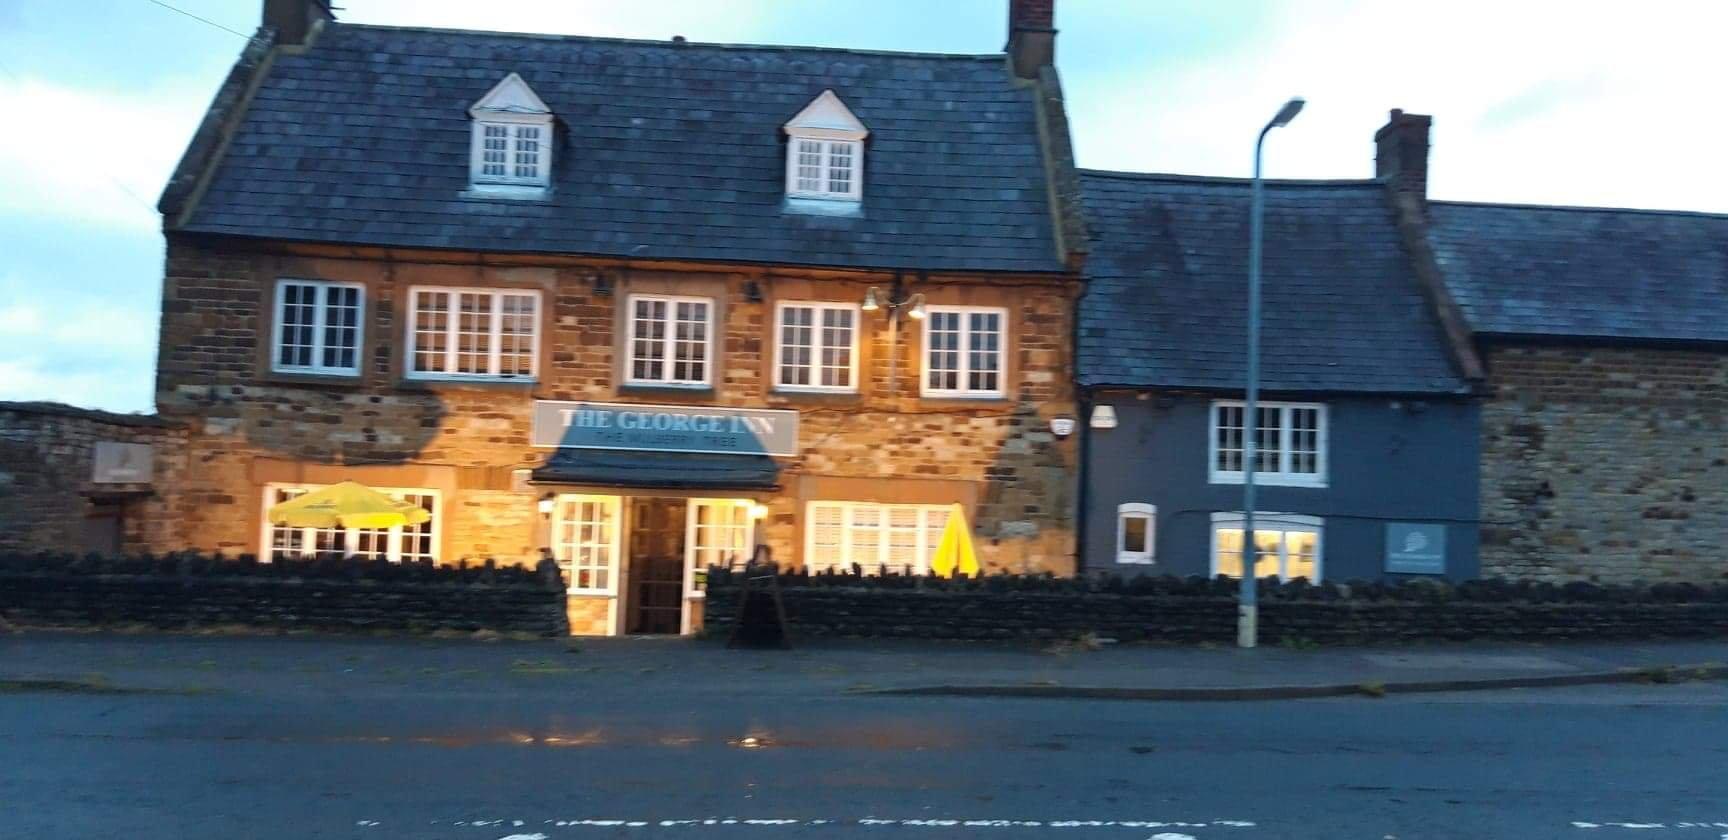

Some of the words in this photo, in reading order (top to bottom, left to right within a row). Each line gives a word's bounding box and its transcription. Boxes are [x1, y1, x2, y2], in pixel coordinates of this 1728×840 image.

[559, 409, 611, 428] THE
[617, 411, 725, 433] GEORGE
[729, 415, 776, 434] INN
[703, 435, 737, 447] TREE
